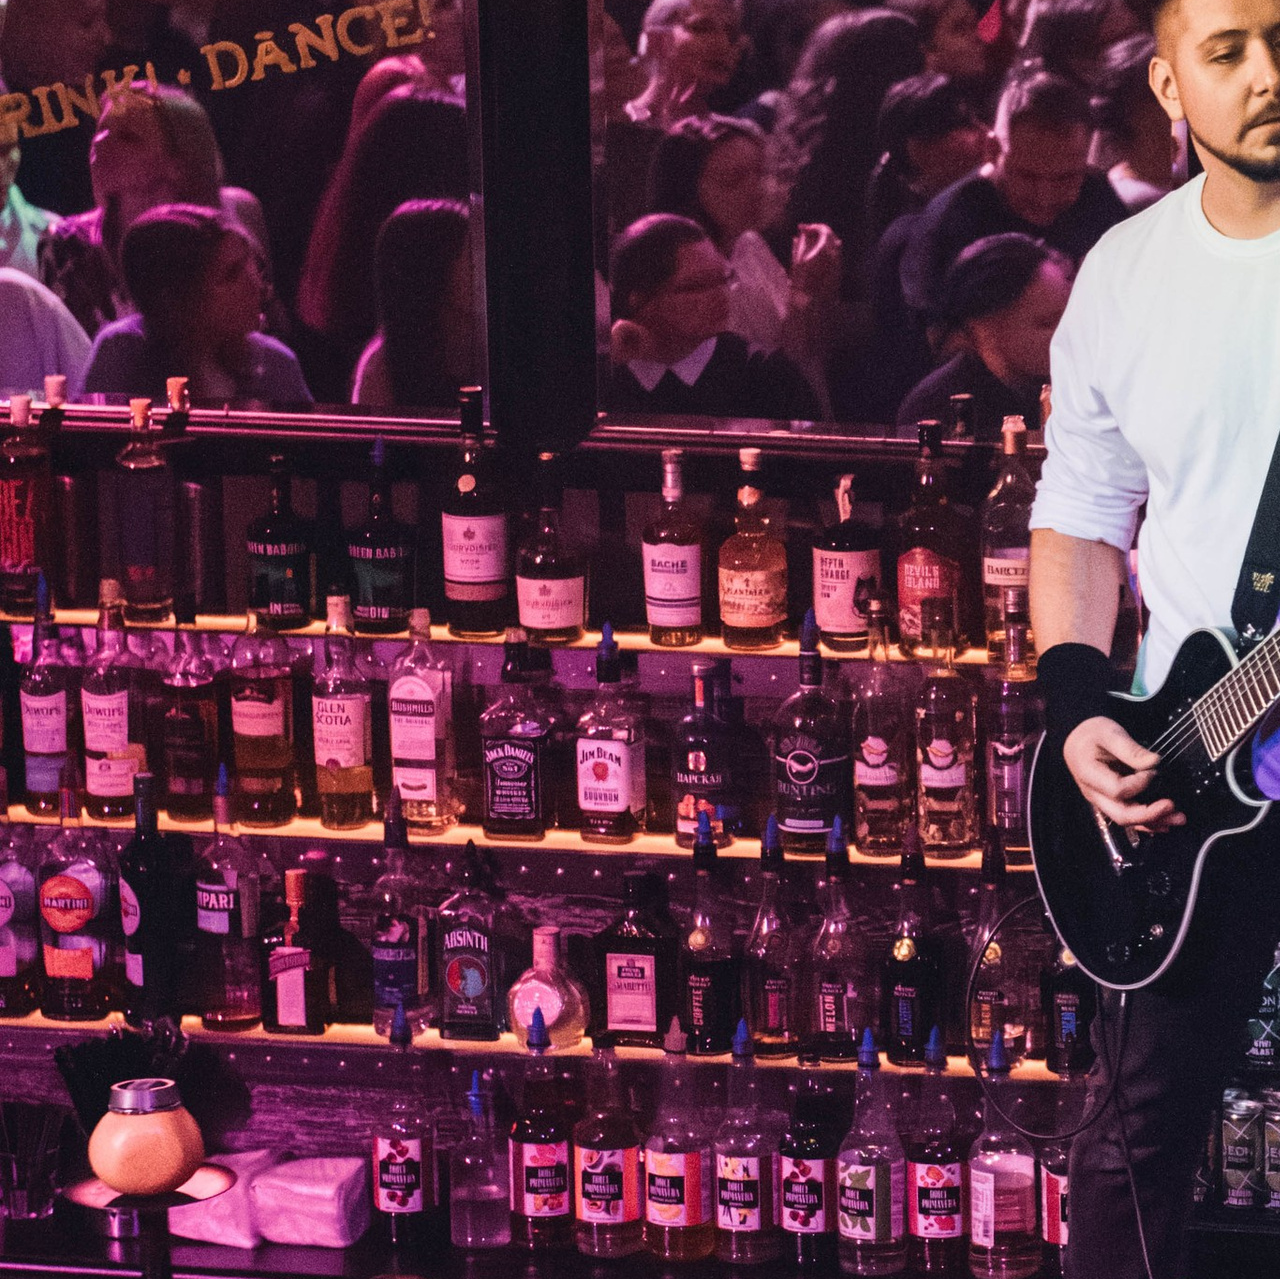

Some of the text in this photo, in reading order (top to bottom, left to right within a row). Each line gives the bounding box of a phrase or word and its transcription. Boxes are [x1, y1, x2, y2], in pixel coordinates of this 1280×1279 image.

[317, 702, 346, 714] GLEN
[391, 702, 433, 714] BUSHMILLS
[316, 713, 351, 726] SCOTIA
[580, 747, 622, 767] JIM BEAM
[44, 898, 90, 909] MARTINI
[443, 930, 489, 952] ABSINTH
[824, 995, 836, 1032] MELON
